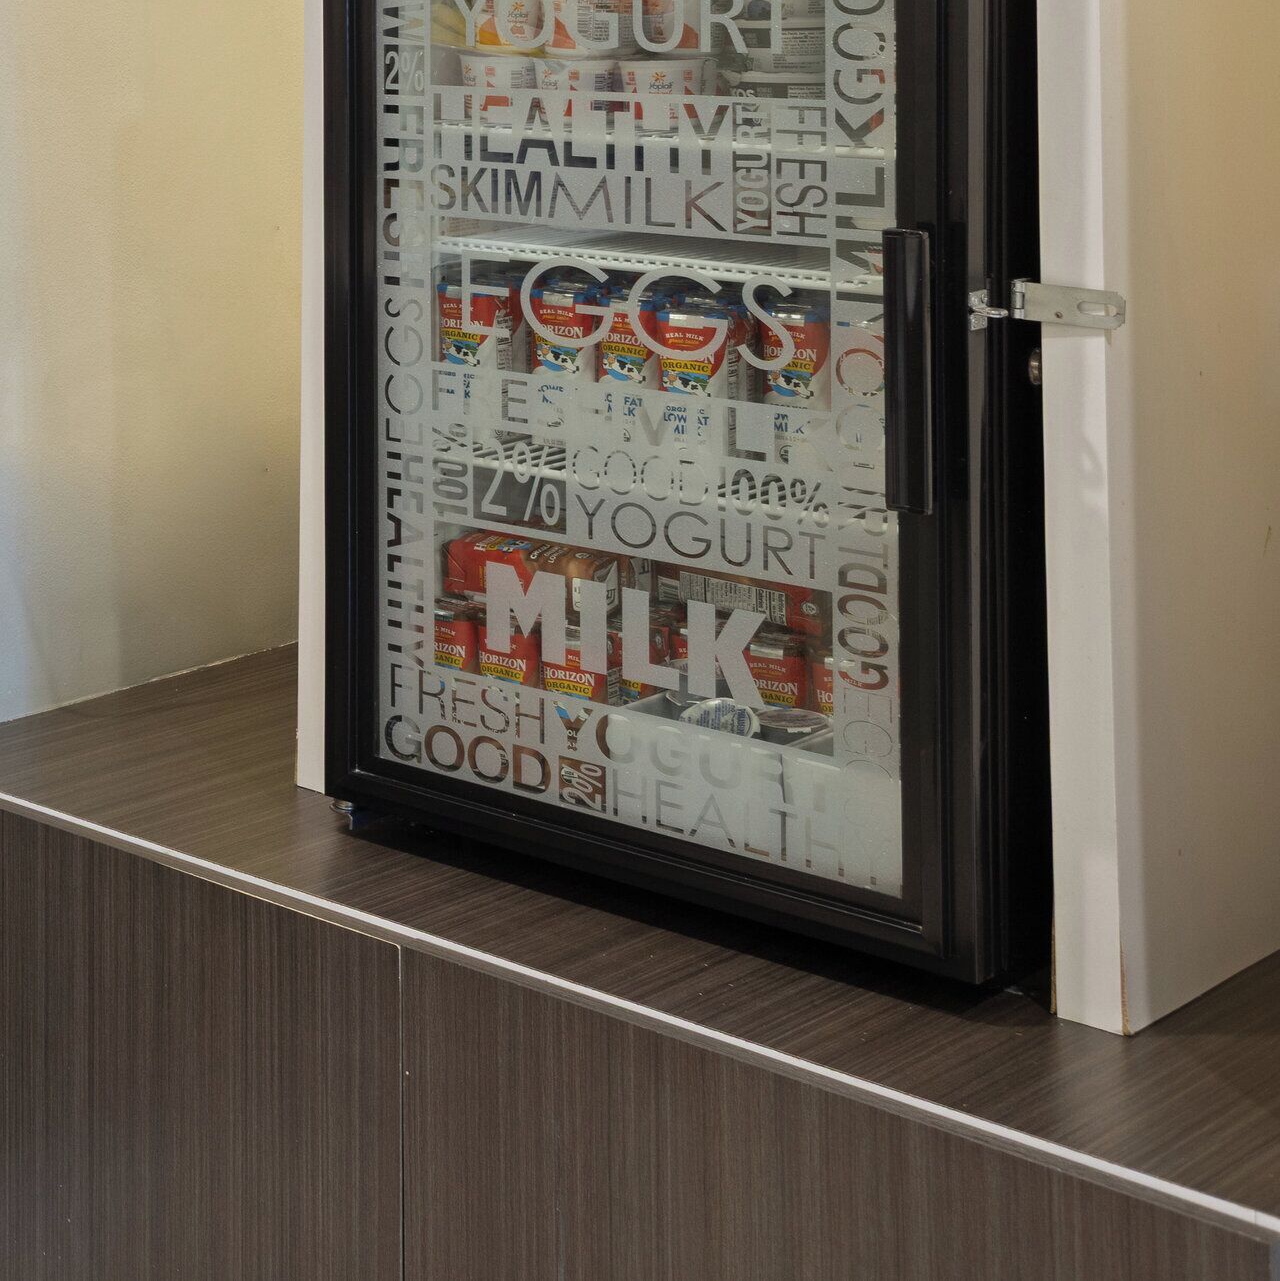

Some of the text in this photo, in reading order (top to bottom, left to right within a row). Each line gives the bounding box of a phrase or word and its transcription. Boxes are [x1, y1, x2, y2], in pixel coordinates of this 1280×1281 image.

[384, 49, 424, 93] 2%
[432, 92, 731, 176] HEALTHY
[430, 163, 728, 232] SKIM MILK
[462, 251, 794, 371] EGGS
[602, 344, 645, 357] ORGANIC
[686, 333, 705, 342] MILK
[662, 361, 709, 373] ORGANIC
[481, 439, 561, 526] 2%
[575, 493, 826, 580] YOGURT
[486, 560, 768, 709] MILK
[837, 561, 890, 690] GOOD
[433, 642, 466, 658] RIZON
[479, 650, 527, 672] HORIZON
[481, 664, 521, 680] ORGANIC
[543, 666, 595, 687] HORIZON
[545, 680, 590, 695] ORGANIC
[753, 677, 798, 696] ORIZON
[390, 662, 545, 745] FRESH
[760, 690, 793, 704] GANIC
[384, 714, 552, 795] GOOD
